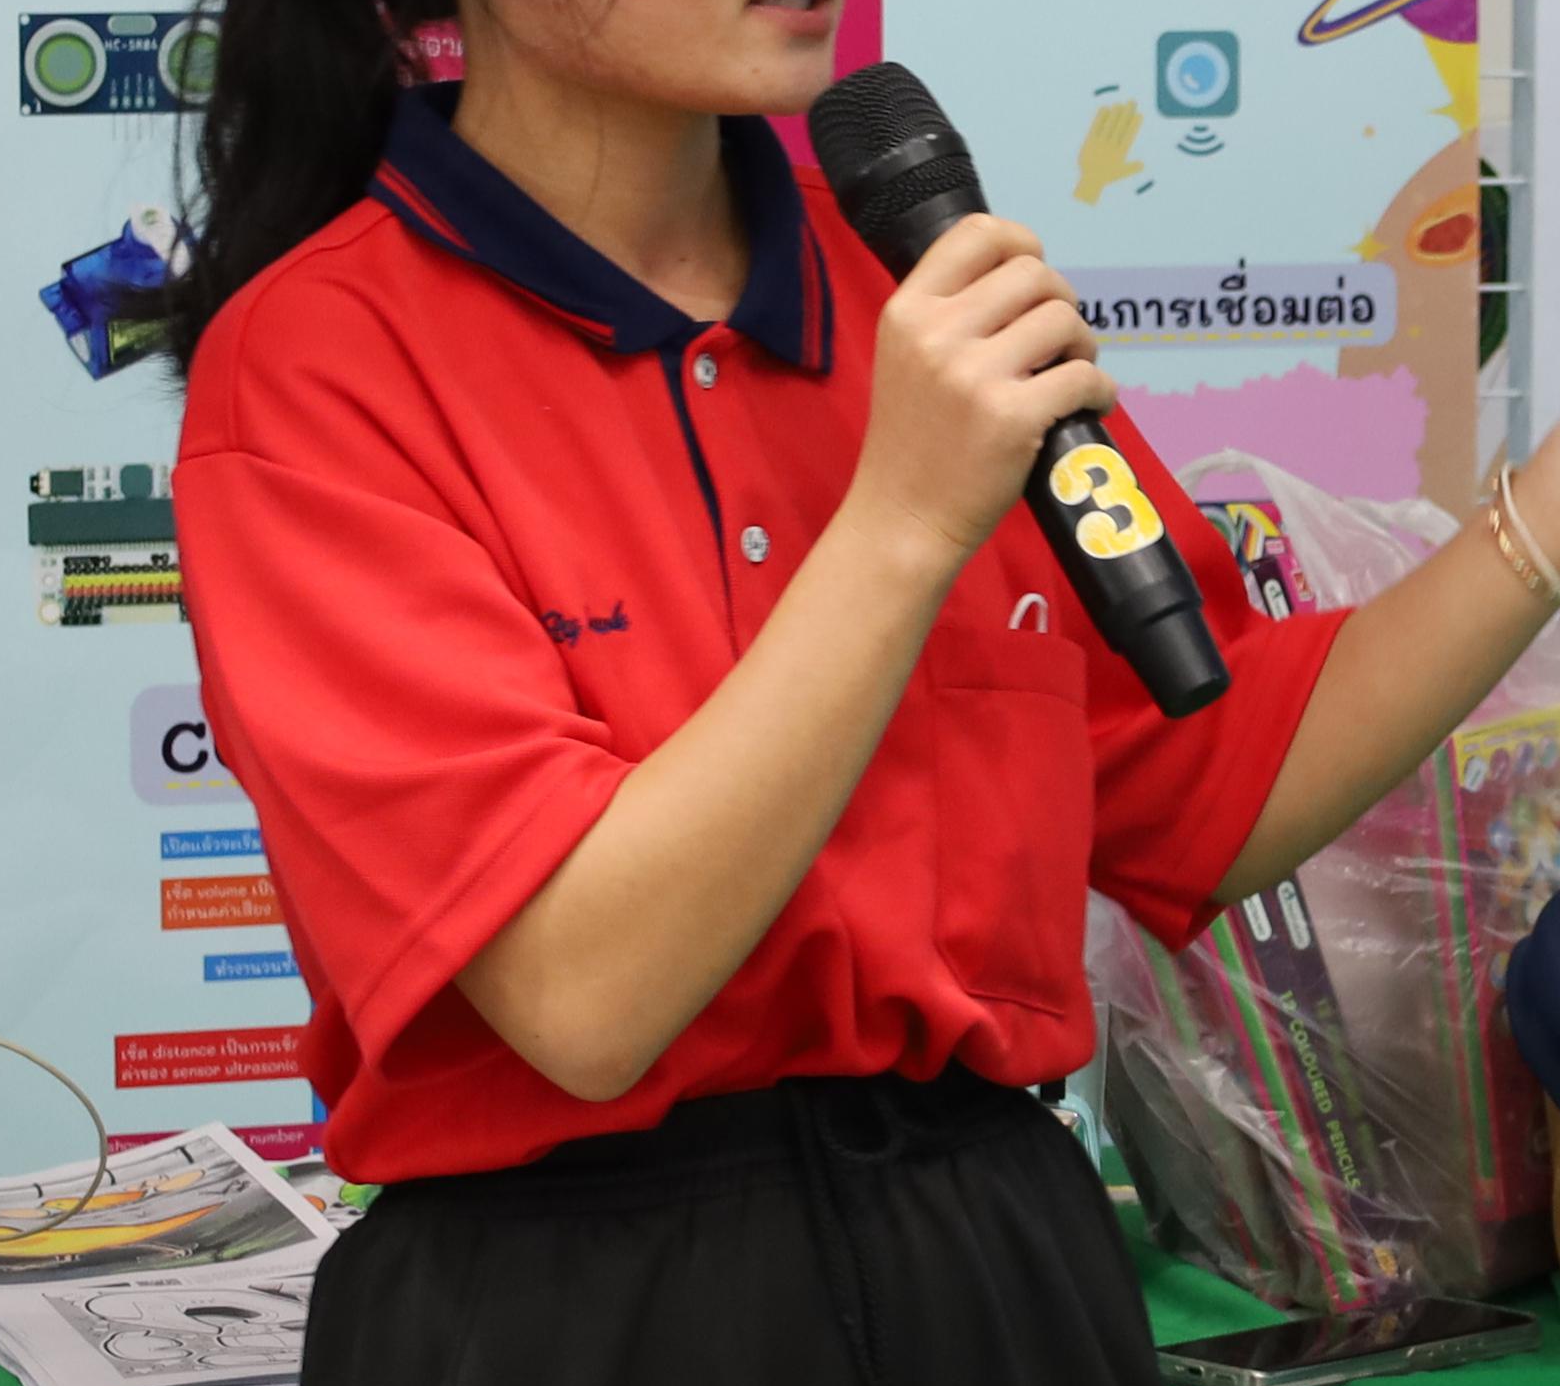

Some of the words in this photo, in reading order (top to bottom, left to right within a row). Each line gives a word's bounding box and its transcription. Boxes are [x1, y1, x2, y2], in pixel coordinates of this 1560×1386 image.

[1049, 443, 1165, 560] 3
[152, 1043, 216, 1059] distance
[172, 1066, 221, 1080] sensor
[226, 1059, 299, 1077] ultrasonic
[1288, 1020, 1333, 1115] COLOURED
[1327, 1120, 1362, 1191] PENCILS
[248, 1130, 305, 1145] number
